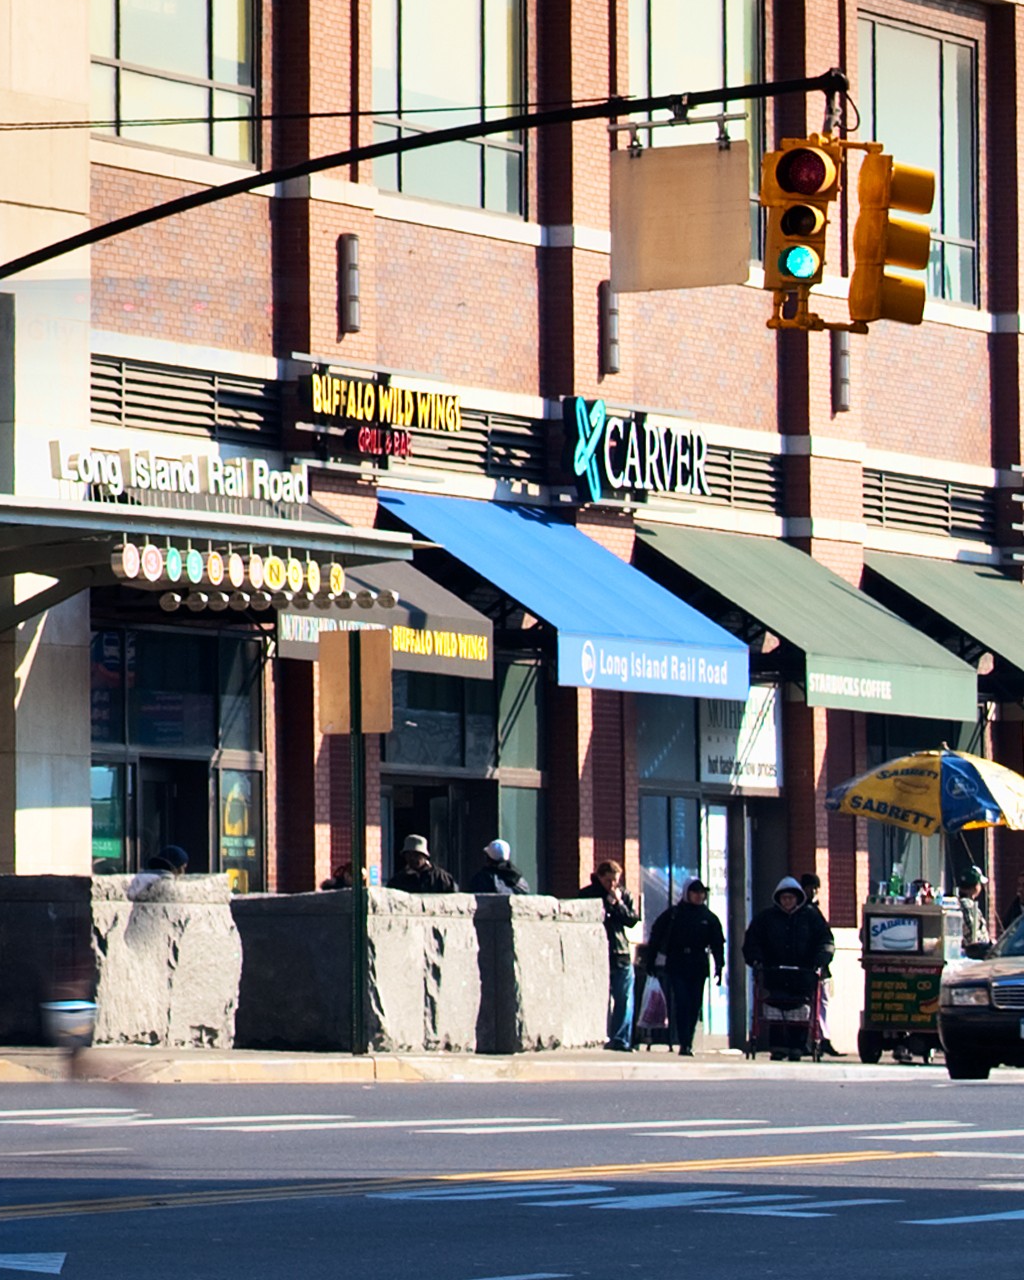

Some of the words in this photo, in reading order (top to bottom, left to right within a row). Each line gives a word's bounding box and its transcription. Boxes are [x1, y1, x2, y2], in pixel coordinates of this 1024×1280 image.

[312, 373, 375, 422] BUFFALO
[378, 384, 414, 427] WILD
[417, 391, 462, 432] WINGS
[358, 426, 383, 455] GRILL
[393, 431, 413, 457] BAR
[604, 416, 712, 496] CARVER
[53, 440, 124, 496] Long
[129, 450, 201, 494] Island
[207, 454, 248, 499] Rail
[253, 458, 309, 504] Road
[393, 624, 433, 656] BUFFALO
[433, 629, 458, 658] WILD
[458, 633, 489, 662] WINGS
[599, 649, 628, 683] Long
[631, 652, 668, 680] Island
[671, 655, 696, 682] Rail
[698, 658, 728, 685] Road
[809, 672, 860, 698] STARBUCKS
[860, 678, 893, 701] COFFEE
[876, 767, 938, 781] SABRETT
[849, 795, 934, 829] SABRETT
